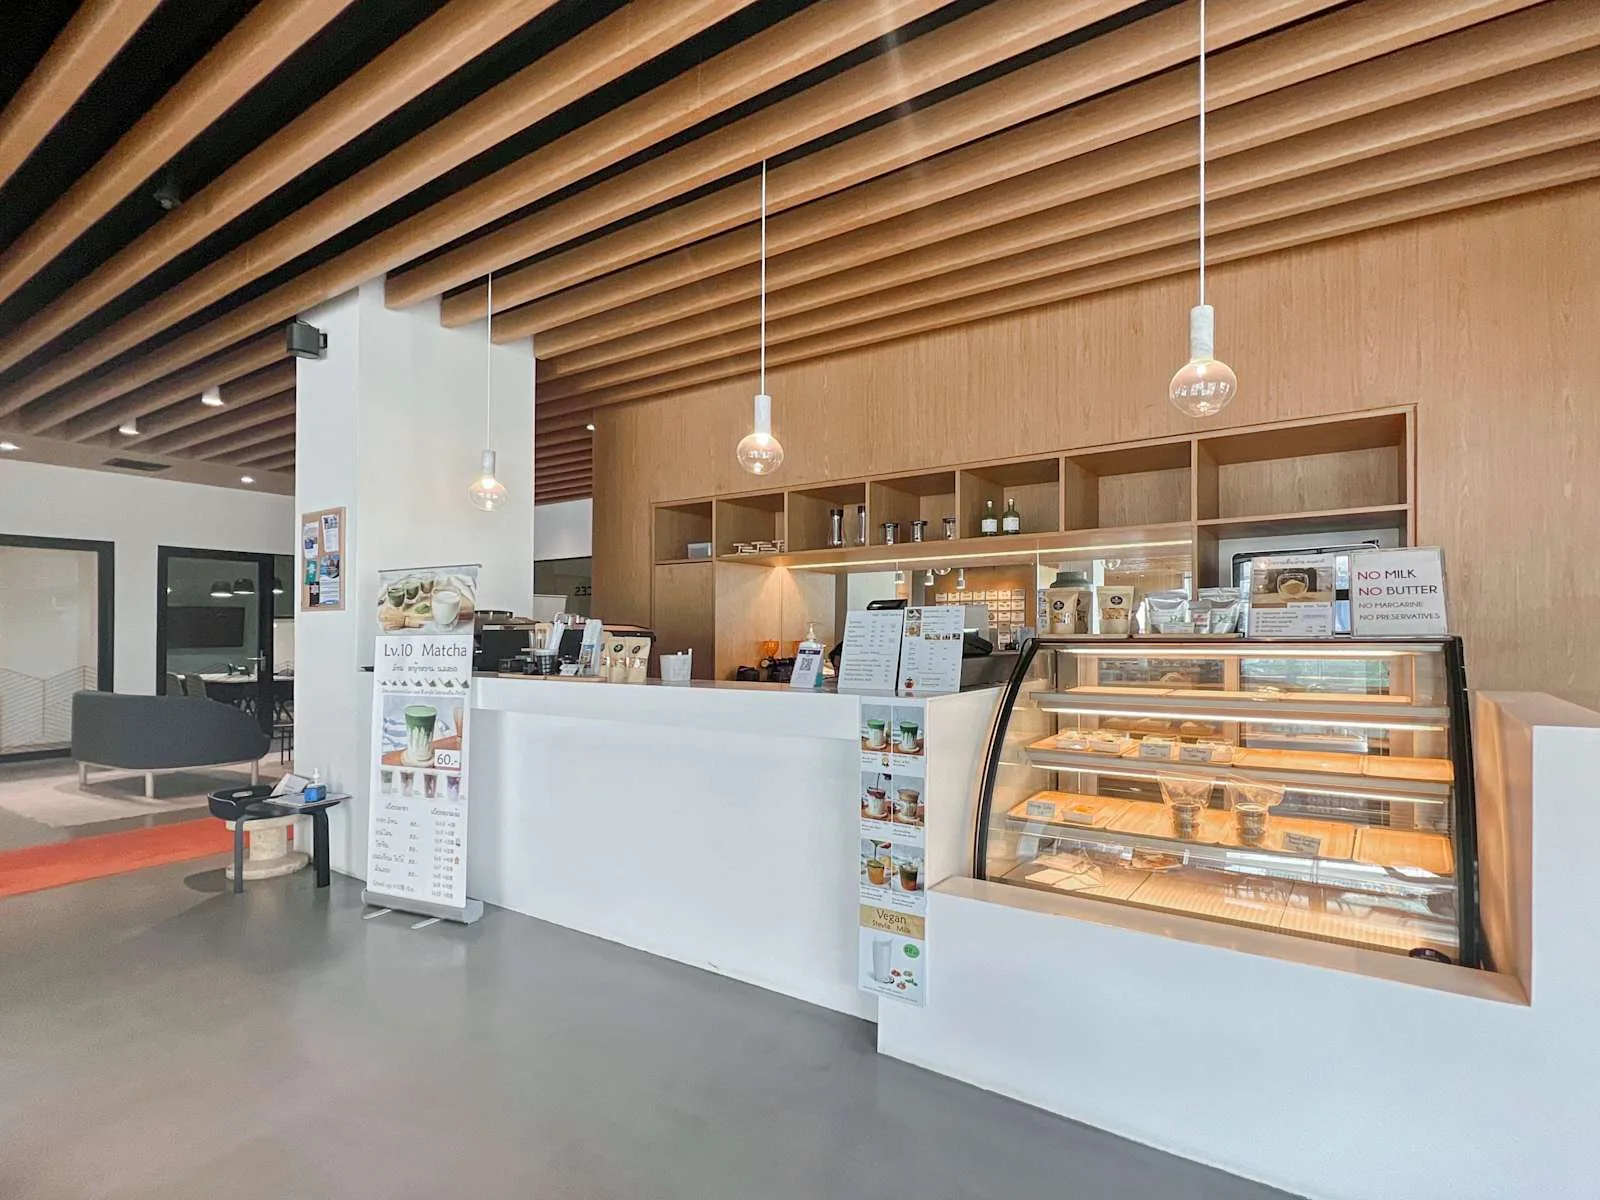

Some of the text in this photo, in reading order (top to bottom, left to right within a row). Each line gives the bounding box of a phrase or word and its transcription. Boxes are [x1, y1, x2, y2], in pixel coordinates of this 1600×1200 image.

[1357, 568, 1417, 581] NO MILK
[1358, 584, 1438, 597] NO BUTTER
[1374, 601, 1424, 609] MARGARINE
[1375, 612, 1441, 621] PRESERVATIVES
[384, 642, 468, 658] Lv.10 Matcha
[876, 909, 907, 925] Vegan
